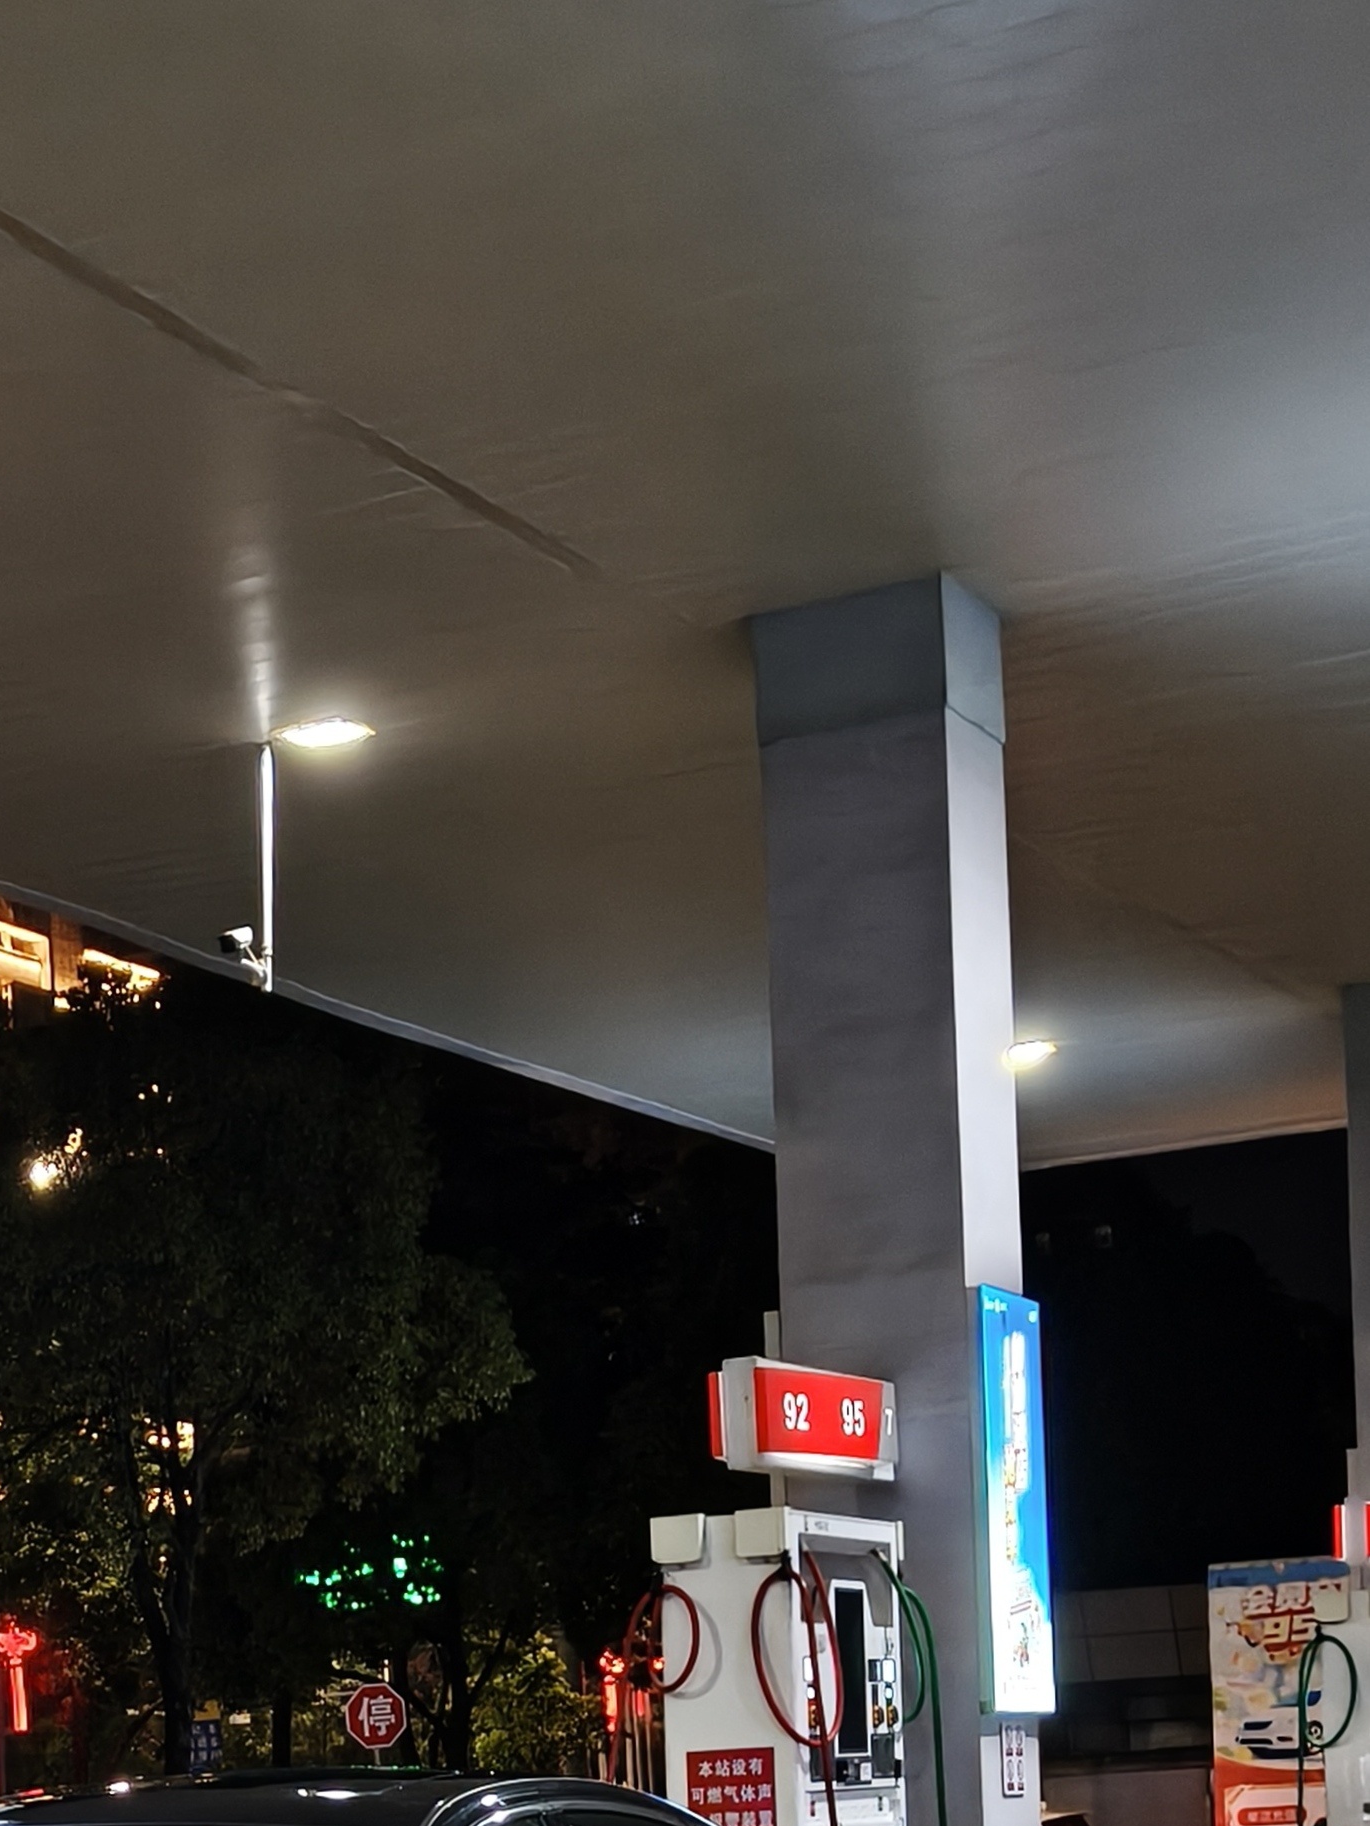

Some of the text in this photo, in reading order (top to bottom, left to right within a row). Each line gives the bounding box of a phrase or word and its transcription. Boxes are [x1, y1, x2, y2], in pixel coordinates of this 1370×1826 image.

[783, 1392, 810, 1431] 92
[842, 1398, 865, 1436] 95
[358, 1695, 396, 1738] 停
[698, 1758, 763, 1778] 本站设有
